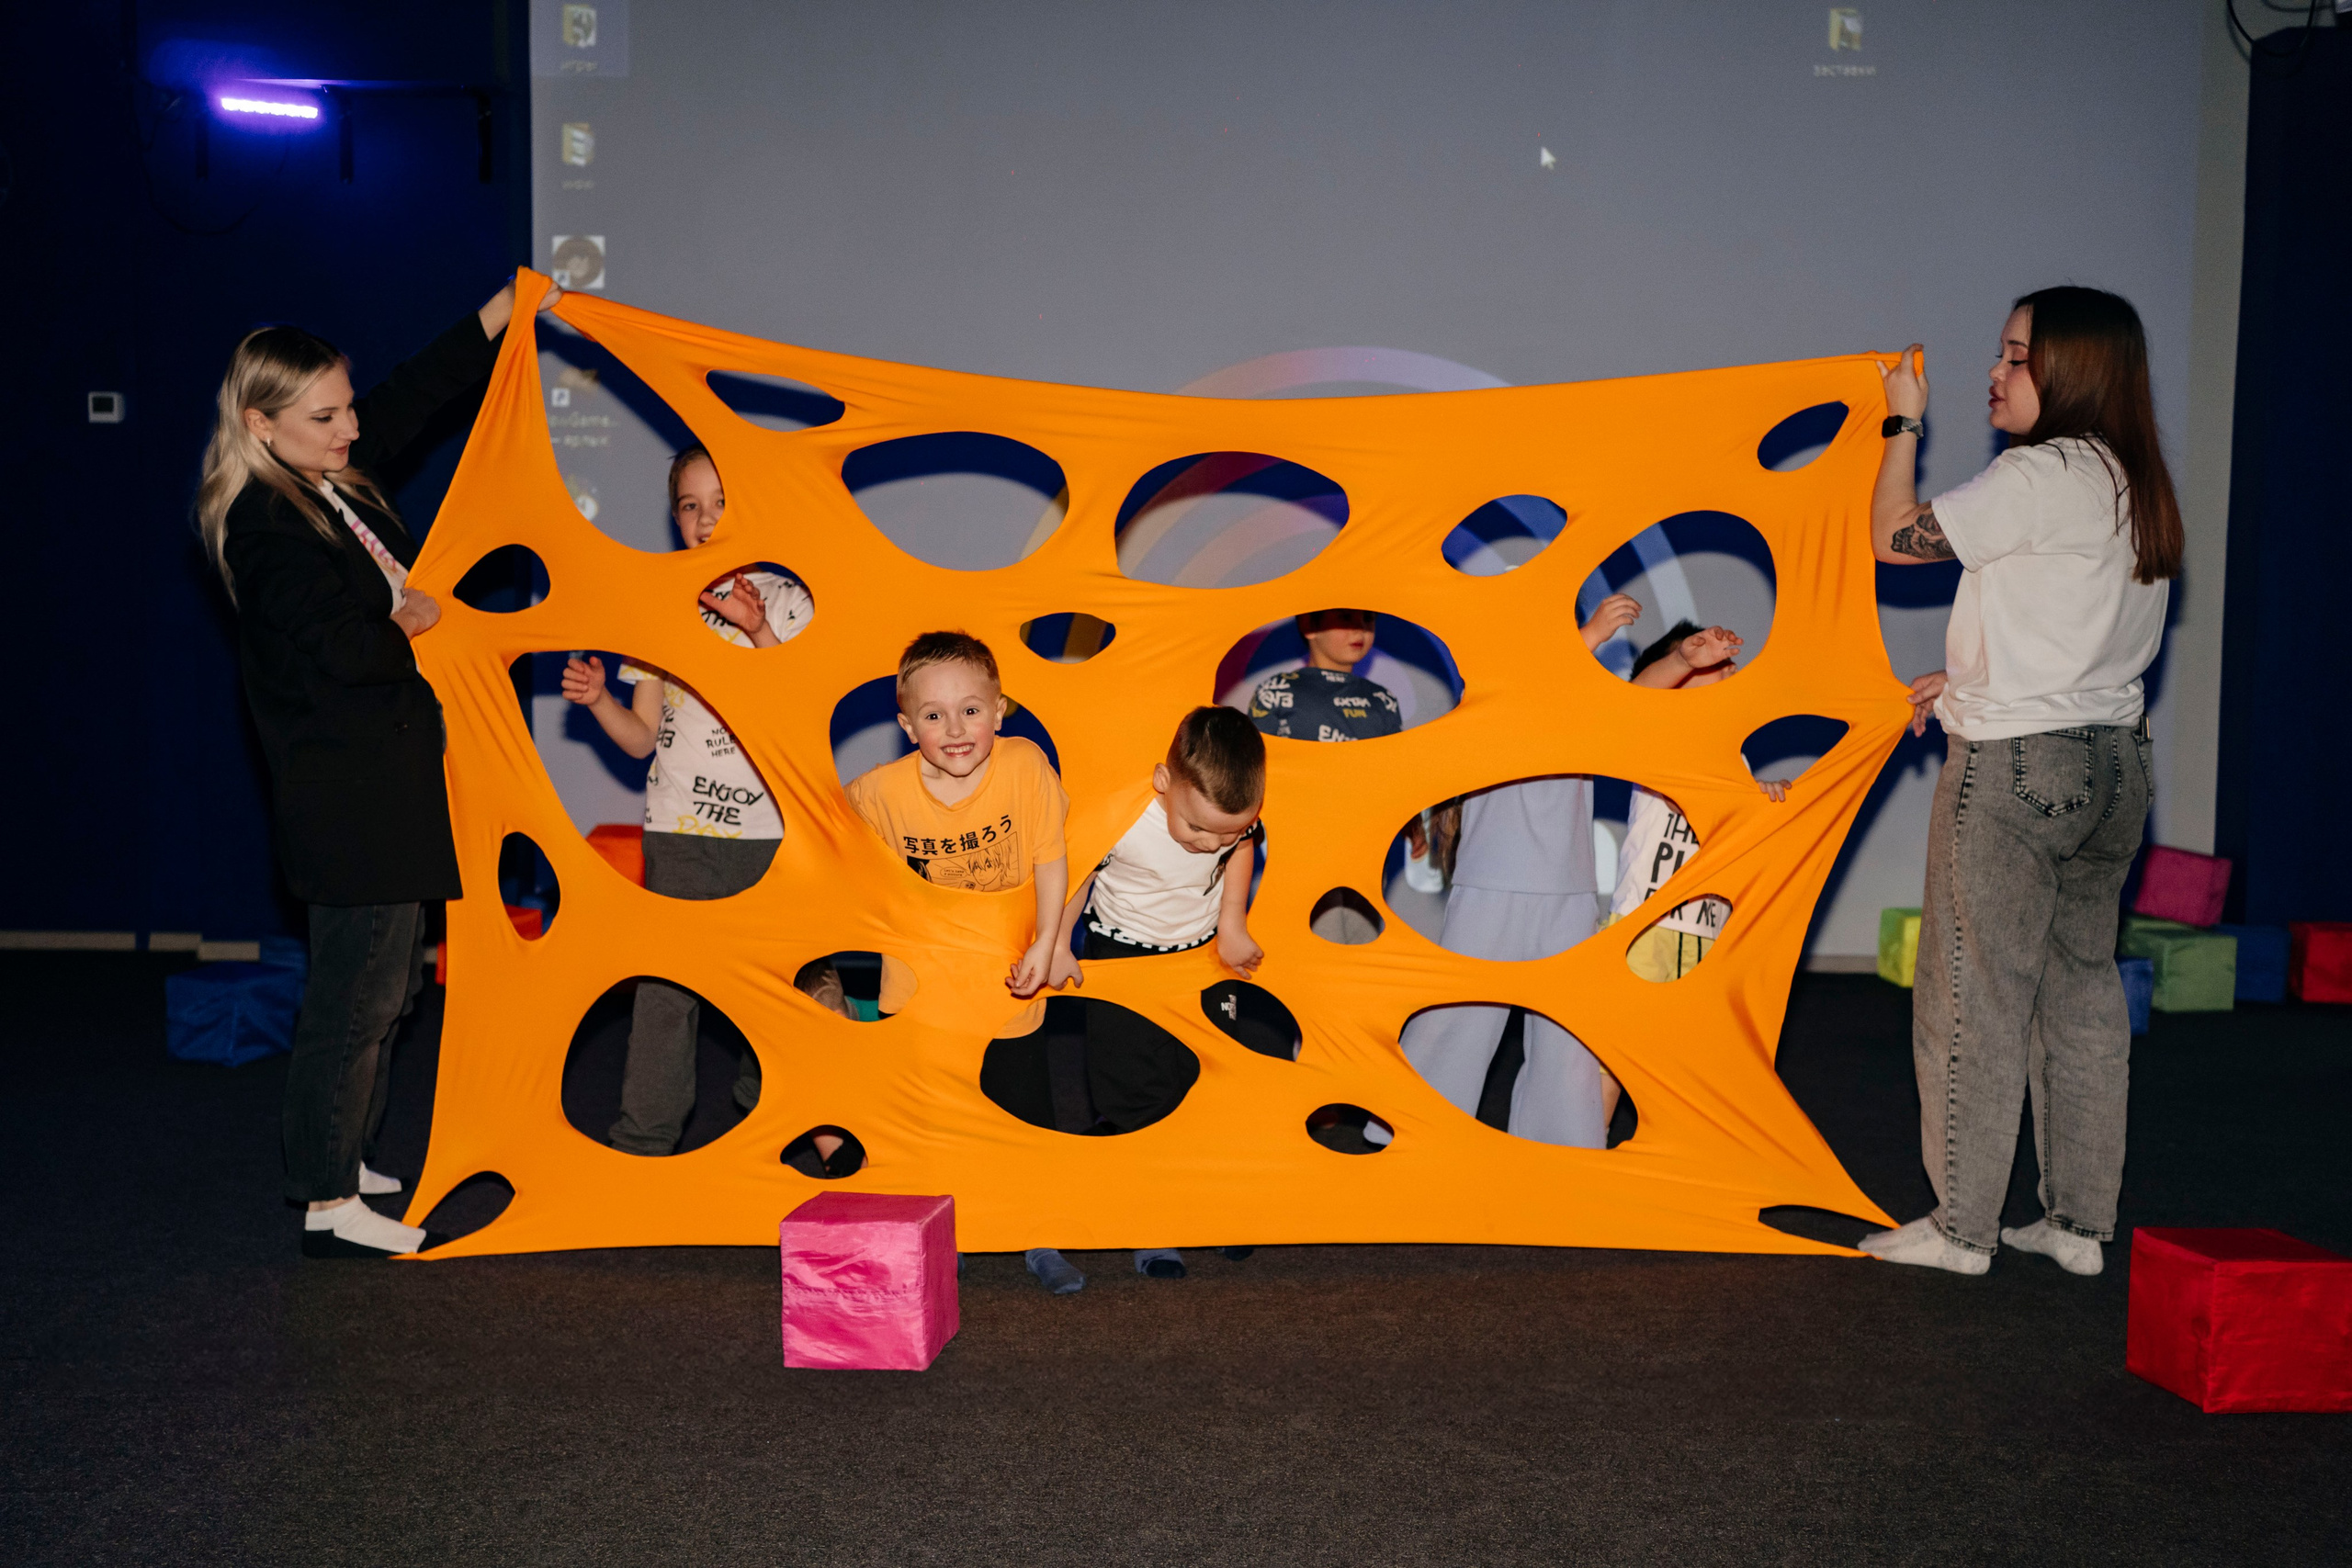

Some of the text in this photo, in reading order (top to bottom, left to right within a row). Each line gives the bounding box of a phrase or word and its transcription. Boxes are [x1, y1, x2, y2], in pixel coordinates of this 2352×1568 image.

[1342, 708, 1368, 718] FUN
[711, 727, 727, 735] NO
[711, 746, 736, 757] HERE
[692, 774, 764, 807] ENJOY
[693, 800, 741, 826] THE
[903, 814, 1012, 856] 写真を撮ろう
